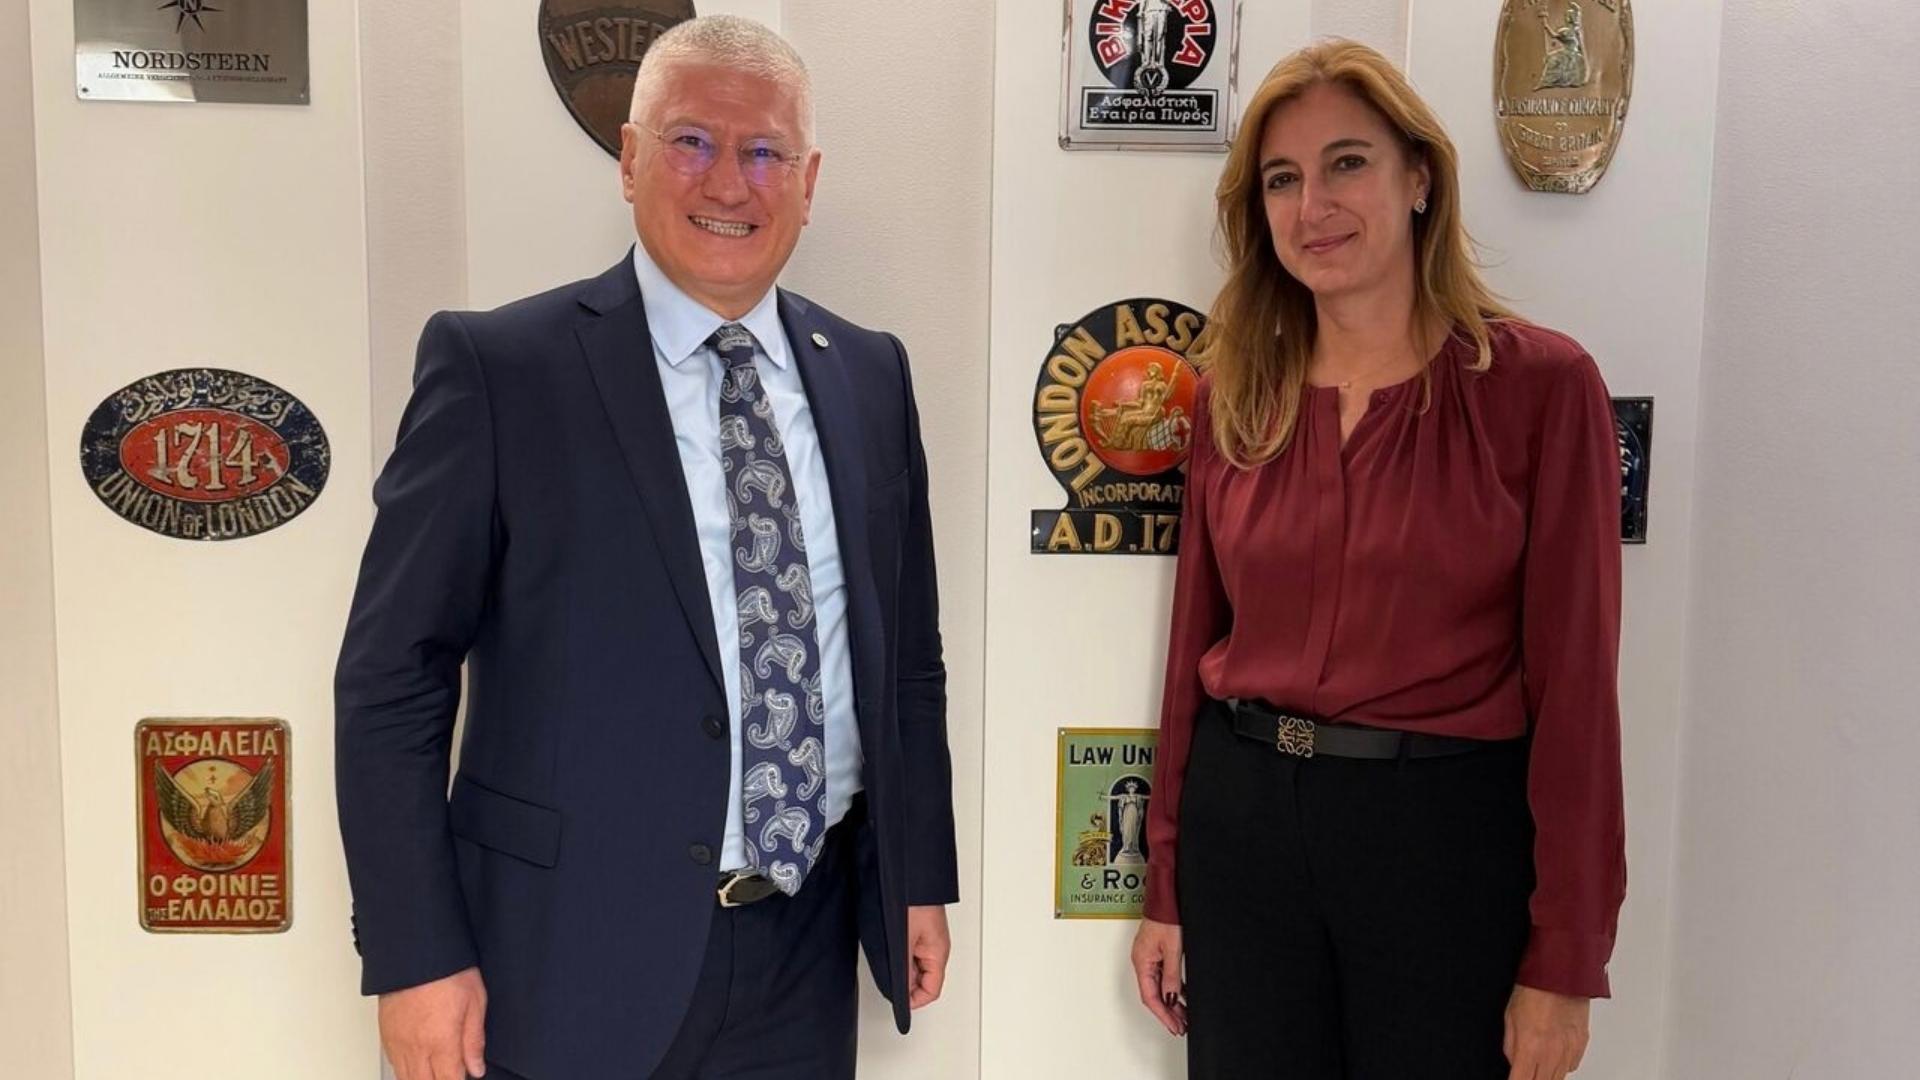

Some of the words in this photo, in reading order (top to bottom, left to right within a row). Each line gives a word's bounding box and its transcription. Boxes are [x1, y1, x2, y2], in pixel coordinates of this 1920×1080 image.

[112, 51, 270, 72] NORDSTERN
[1039, 327, 1107, 491] LONDON
[148, 422, 259, 491] 1714
[98, 469, 185, 534] UNION
[206, 474, 316, 536] LONDON
[146, 731, 278, 756] ΑΣΦΑΛΕΙΑ
[1069, 744, 1114, 765] LAW
[1122, 744, 1158, 765] UN
[172, 874, 279, 897] ΦΟΙΝΙΞ
[1081, 873, 1096, 890] &
[168, 898, 280, 921] ΕΛΛΑΔΟΣ
[1070, 893, 1126, 904] INSURANCE
